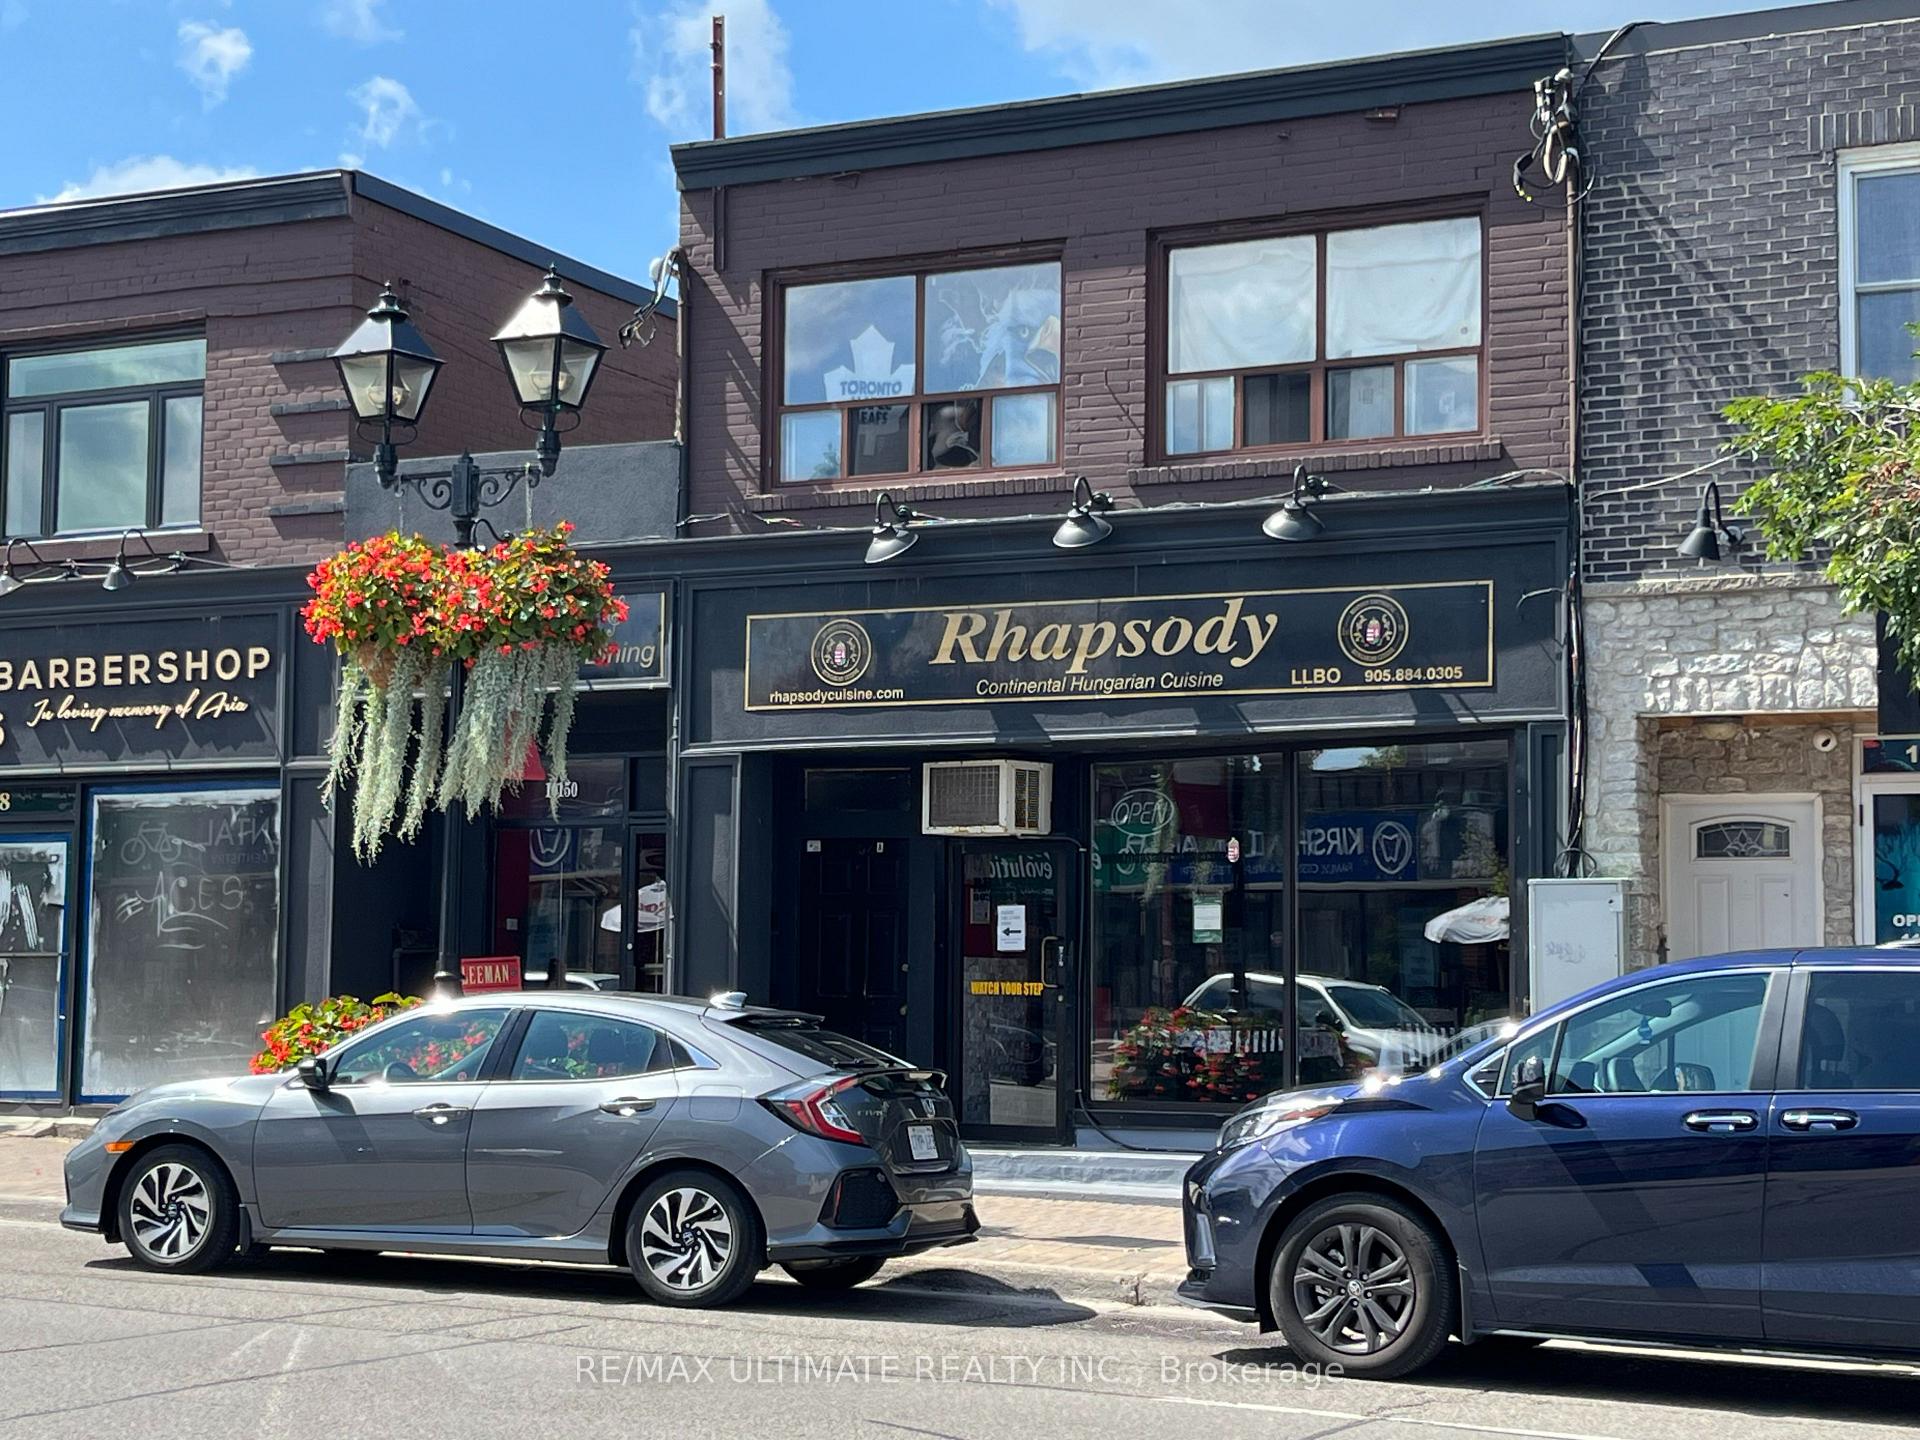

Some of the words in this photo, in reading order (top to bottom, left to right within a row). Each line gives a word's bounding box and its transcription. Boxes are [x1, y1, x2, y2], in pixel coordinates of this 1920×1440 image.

[840, 380, 902, 396] TORONTO
[928, 597, 1278, 674] Rhapsody
[0, 646, 270, 691] BARBERSHOP
[1291, 667, 1341, 685] LLBO
[1364, 665, 1463, 682] 905.884.0305
[976, 678, 1066, 696] Continental
[1070, 674, 1155, 696] Hungarian
[1160, 672, 1223, 690] Cuisine
[769, 688, 904, 704] rhapsodycuisine.com
[27, 698, 54, 728] In
[56, 694, 110, 732] loving
[108, 704, 173, 729] memory
[174, 688, 200, 720] of
[196, 691, 249, 720] Aria
[1905, 744, 1918, 763] 1
[544, 781, 578, 798] 1150
[1115, 801, 1169, 825] OPEN
[461, 964, 509, 985] LEEMAN
[971, 981, 999, 996] WATCH
[1001, 982, 1023, 996] YOUR
[1023, 982, 1044, 996] STEP
